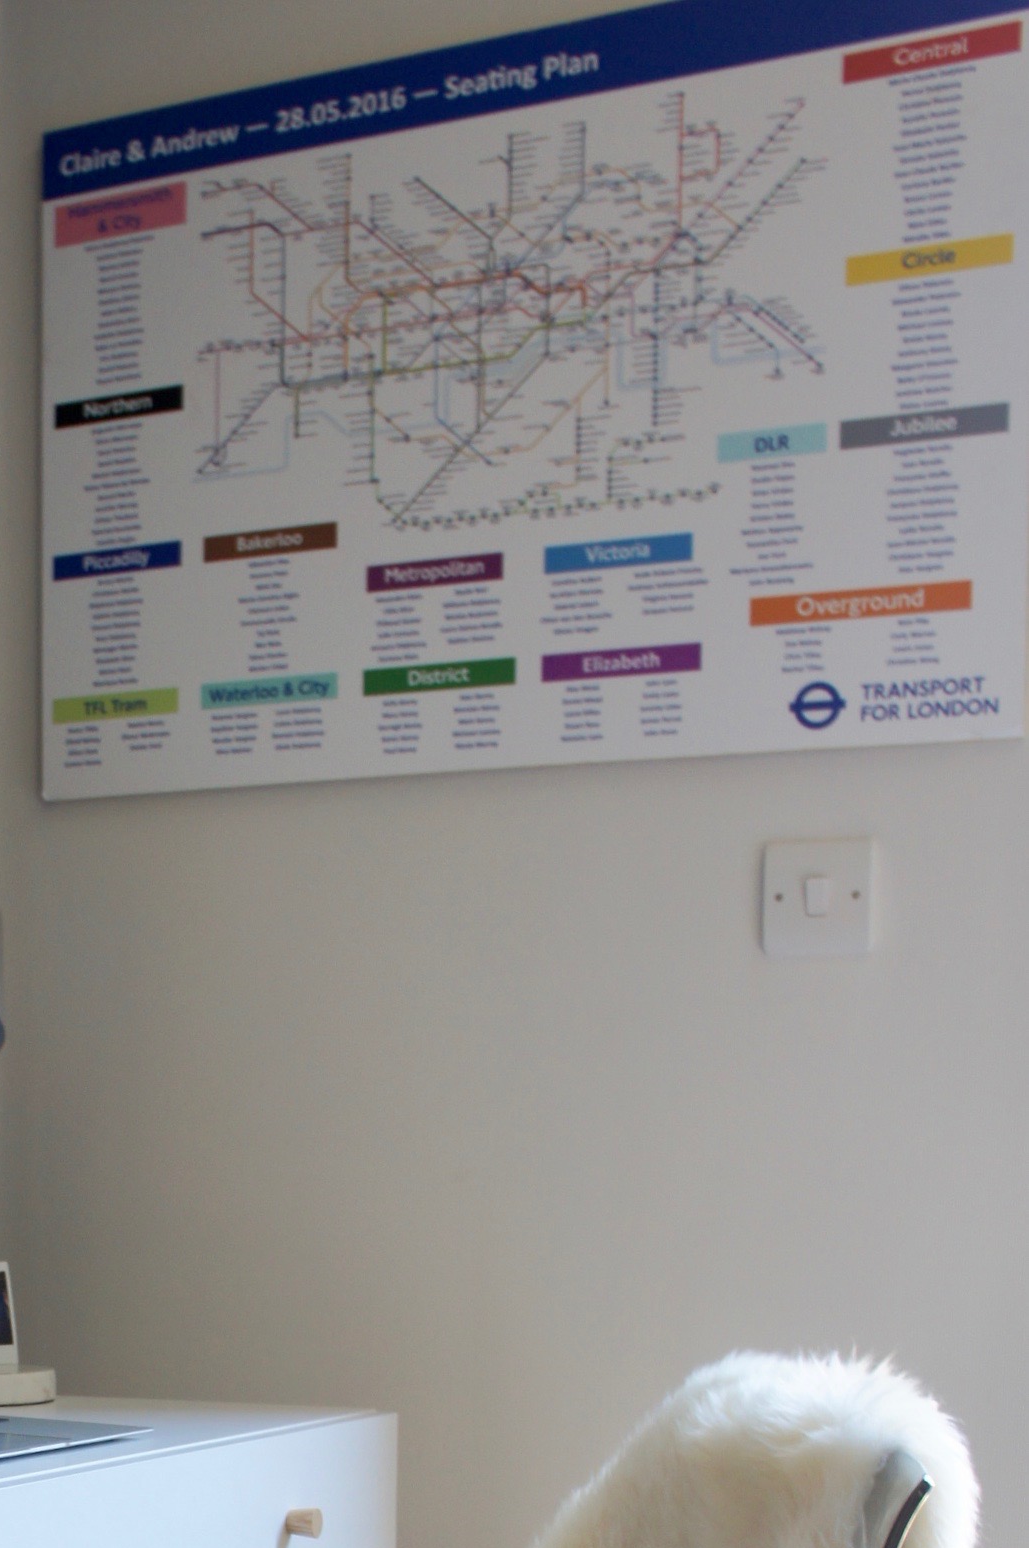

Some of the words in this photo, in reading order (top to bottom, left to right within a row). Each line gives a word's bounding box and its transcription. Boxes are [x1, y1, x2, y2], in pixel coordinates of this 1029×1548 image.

[892, 37, 969, 66] Central
[59, 146, 121, 176] Claire
[126, 139, 146, 163] &
[151, 125, 241, 158] Andrew
[276, 86, 407, 133] 28.05.2016
[444, 64, 538, 99] Seating
[543, 51, 600, 80] Plan
[901, 249, 957, 269] Circle
[82, 397, 154, 419] Northern
[890, 415, 958, 437] Jubilee
[753, 434, 790, 453] DLR
[236, 532, 303, 551] Bakerloo
[82, 550, 151, 573] Piccadilly
[585, 544, 652, 562] Victoria
[384, 560, 485, 584] Metropolitan
[795, 589, 925, 617] Overground
[582, 653, 661, 673] Elizabeth
[407, 667, 469, 686] District
[209, 684, 278, 704] Waterloo
[283, 682, 293, 697] &
[298, 680, 330, 698] City
[860, 675, 986, 701] TRANSPORT
[111, 698, 148, 713] Tram
[860, 703, 901, 723] FOR
[908, 698, 1000, 720] LONDON
